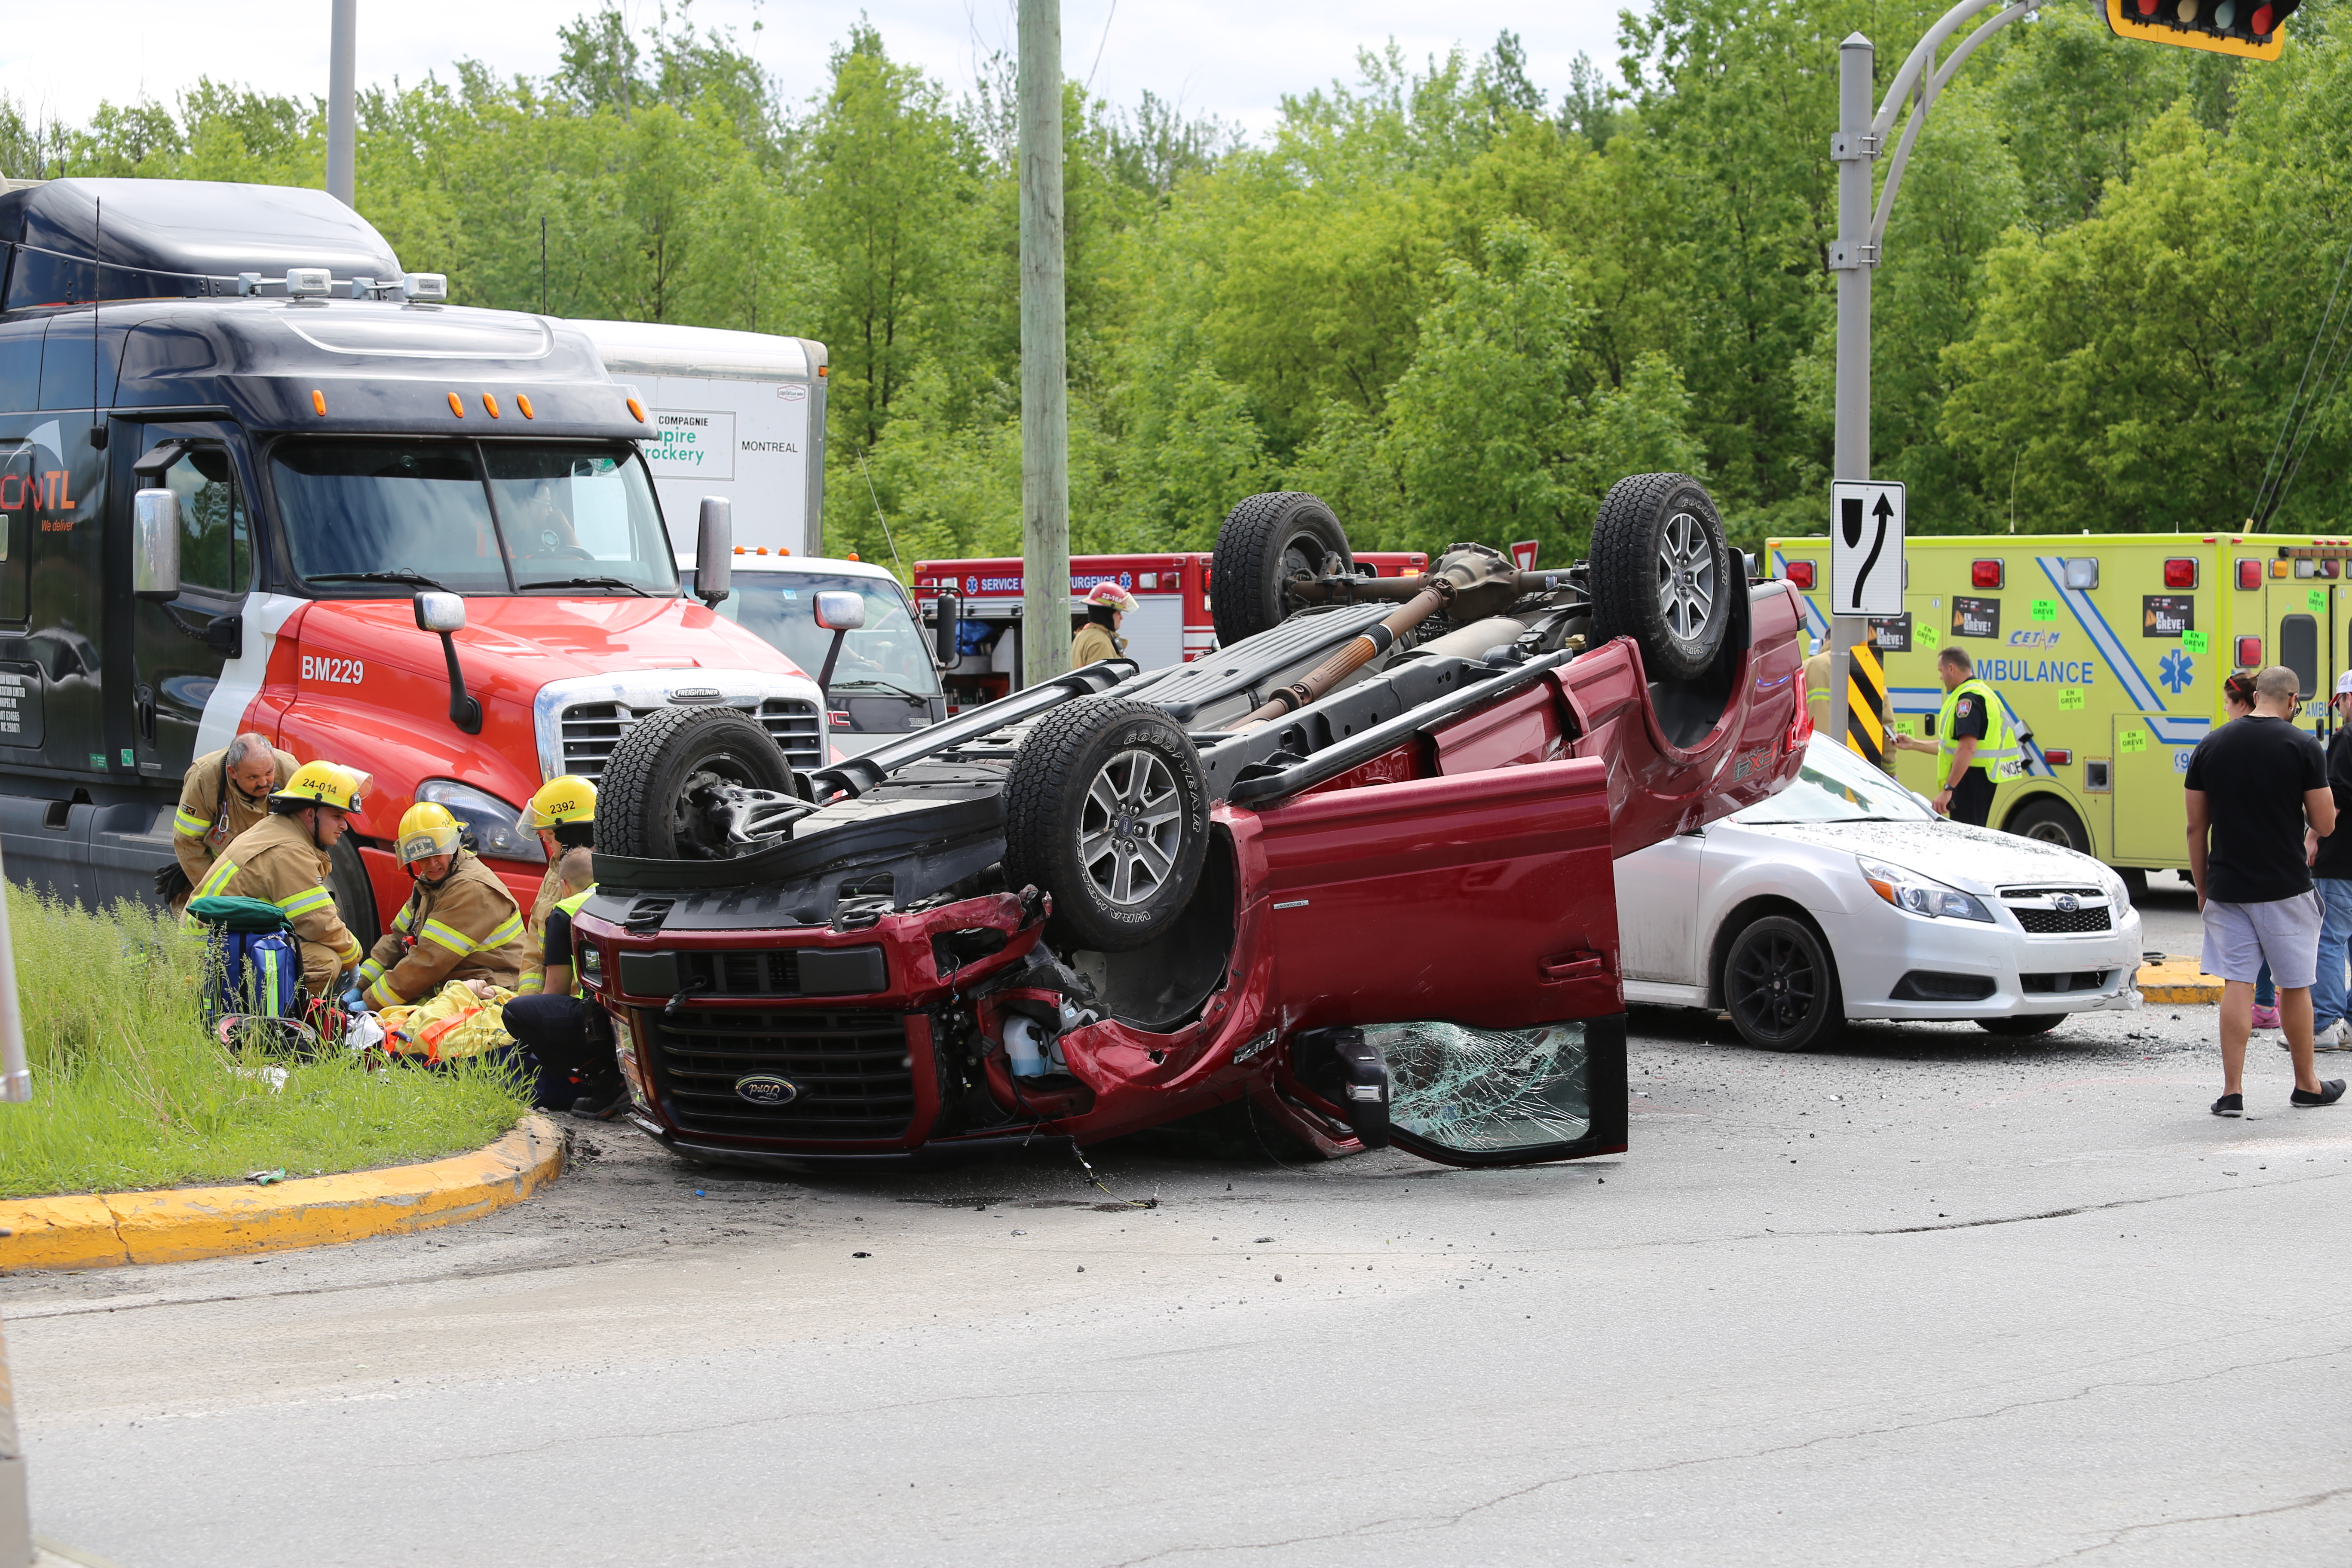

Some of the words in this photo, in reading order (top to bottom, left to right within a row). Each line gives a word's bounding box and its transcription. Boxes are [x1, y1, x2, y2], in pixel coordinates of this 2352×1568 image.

[658, 416, 709, 426] COMPAGNIE
[645, 426, 696, 447] pire
[741, 441, 798, 453] MONTREAL
[642, 443, 704, 466] rockery
[42, 520, 51, 532] We
[52, 519, 74, 532] deliver
[981, 578, 1019, 591] SERVICE
[2156, 611, 2164, 619] EN
[1877, 627, 1885, 635] EN
[1924, 625, 1932, 634] EN
[2009, 628, 2061, 646] CETAM
[302, 655, 364, 685] BM229
[1971, 659, 2093, 684] MBULANCE
[6, 675, 21, 686] NATIONAL
[12, 686, 25, 698] LIMITED
[11, 698, 17, 708] MB
[1733, 737, 1779, 782] FX4
[303, 778, 337, 795] 24-014
[1124, 732, 1201, 833] GOODYEAR
[550, 800, 576, 814] 2392
[414, 842, 425, 853] 13
[1075, 827, 1152, 924] WRANGLER
[748, 1084, 780, 1100] Ford
